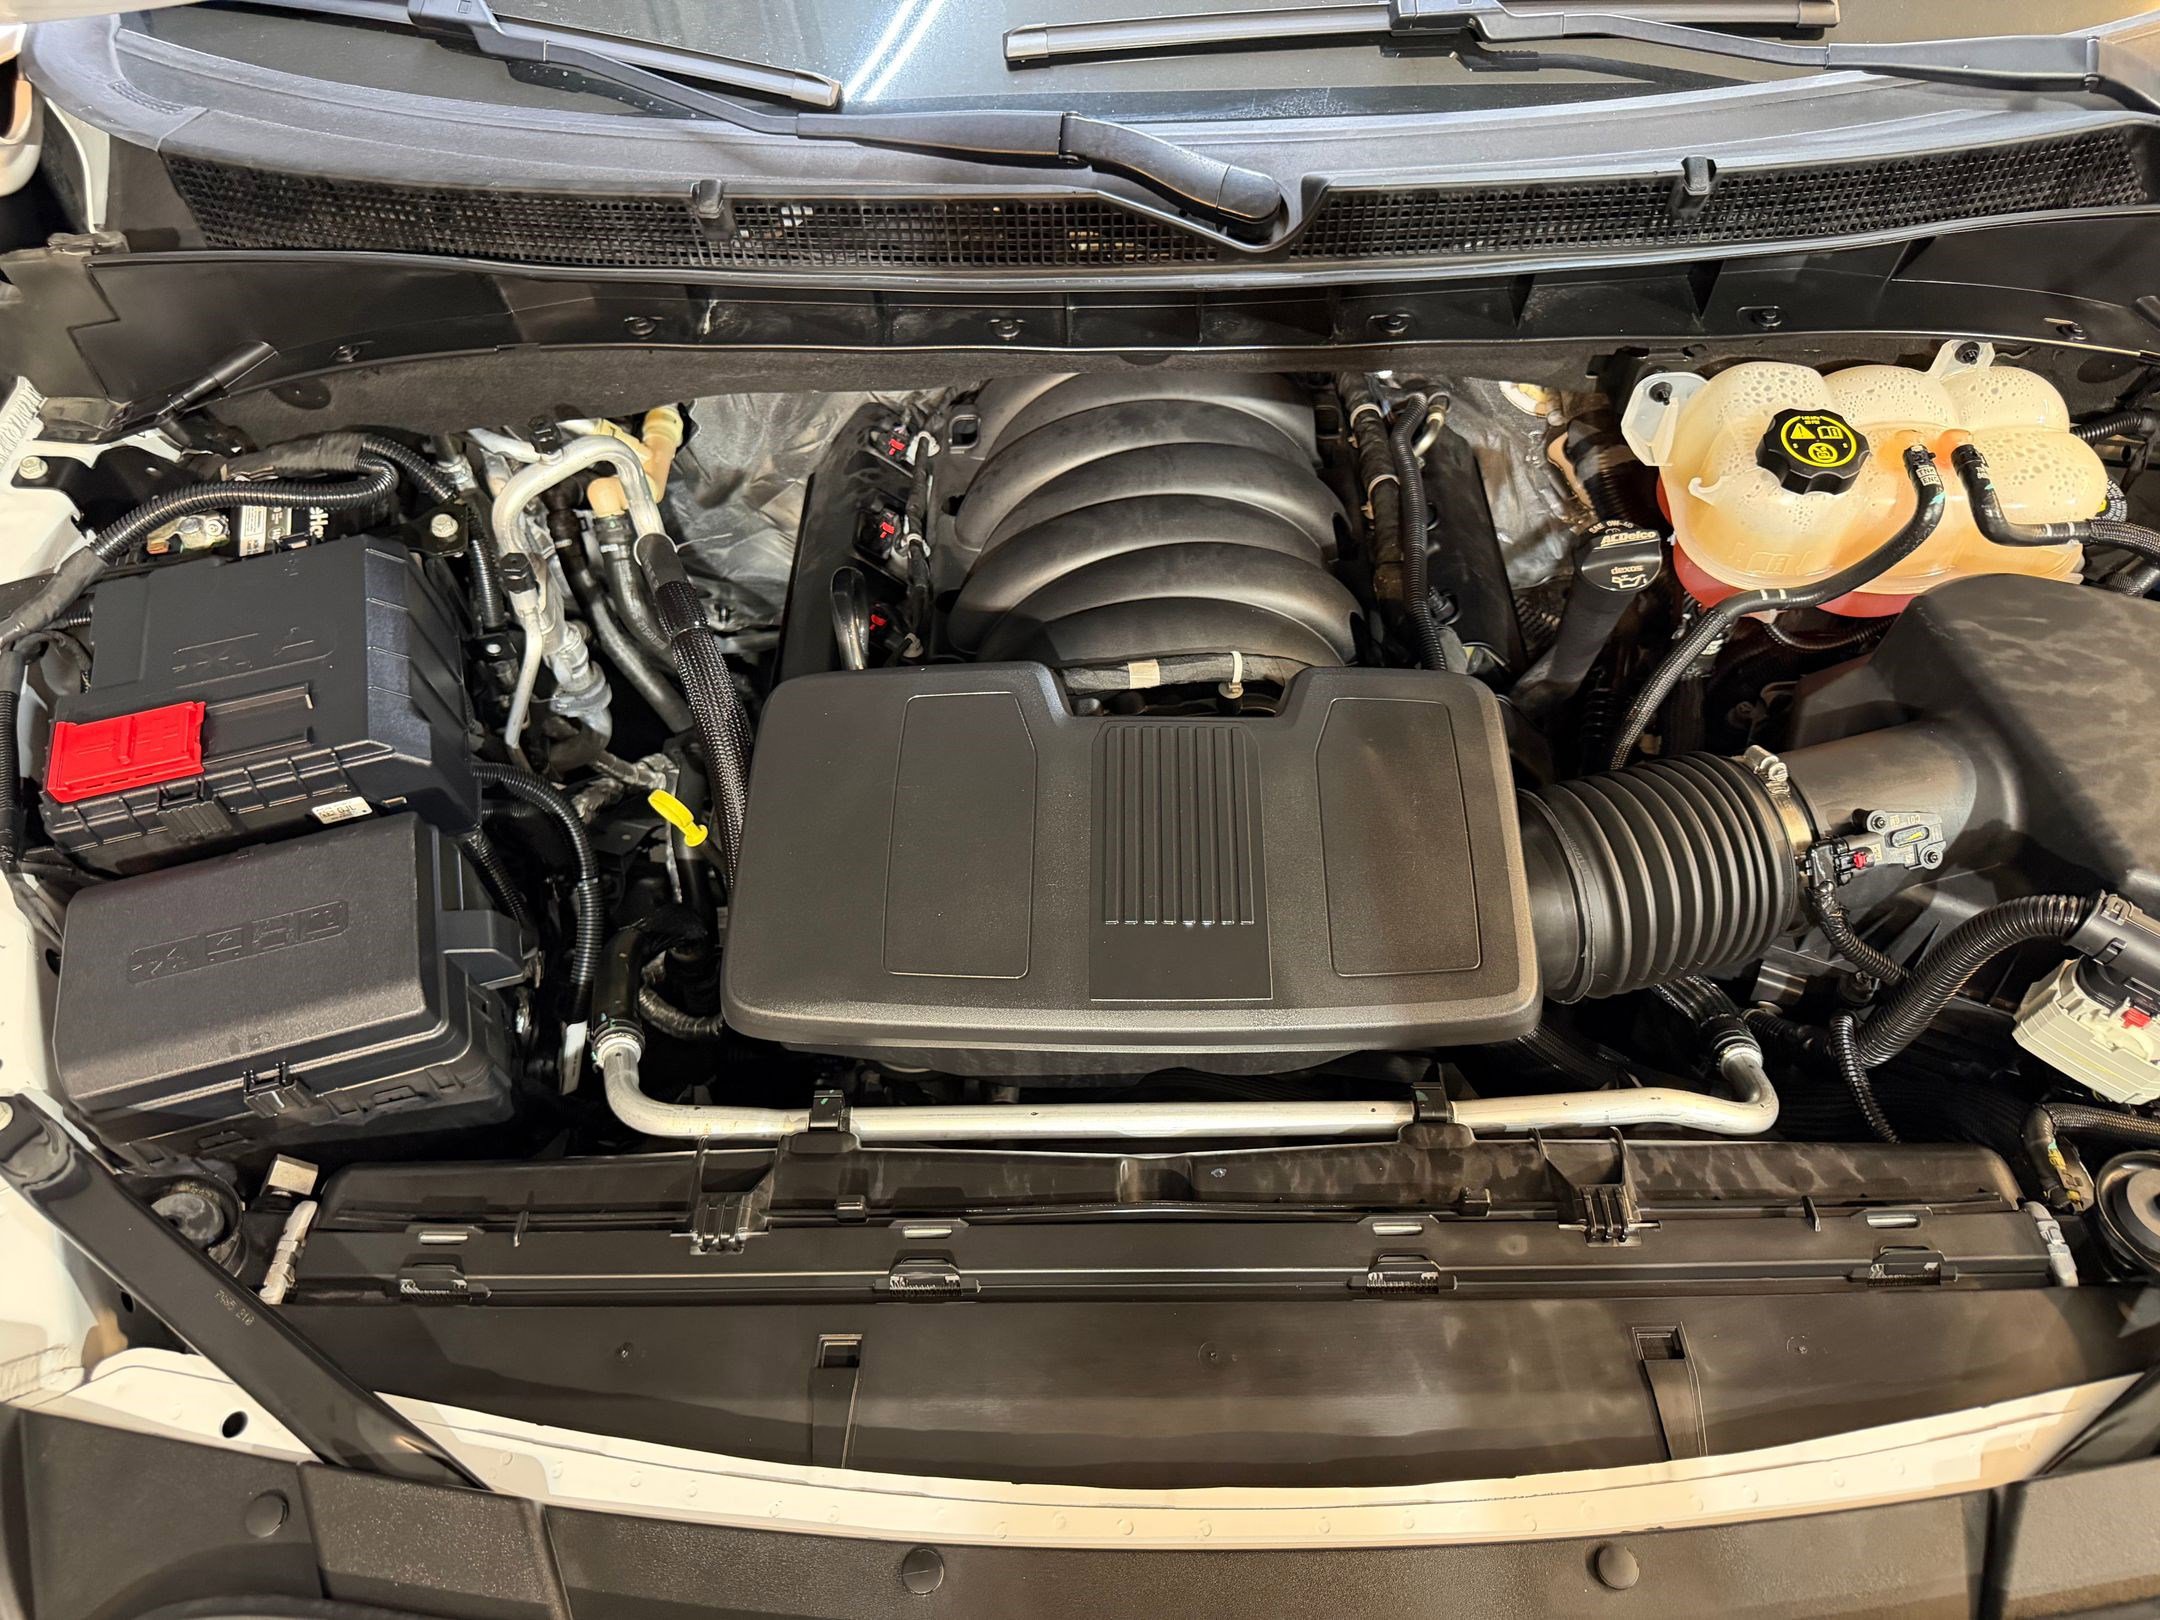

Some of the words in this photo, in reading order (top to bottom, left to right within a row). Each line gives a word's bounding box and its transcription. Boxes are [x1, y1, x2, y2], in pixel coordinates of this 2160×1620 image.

[1588, 522, 1605, 534] SAE
[1600, 530, 1657, 546] ACDelco
[1611, 565, 1644, 575] dexos
